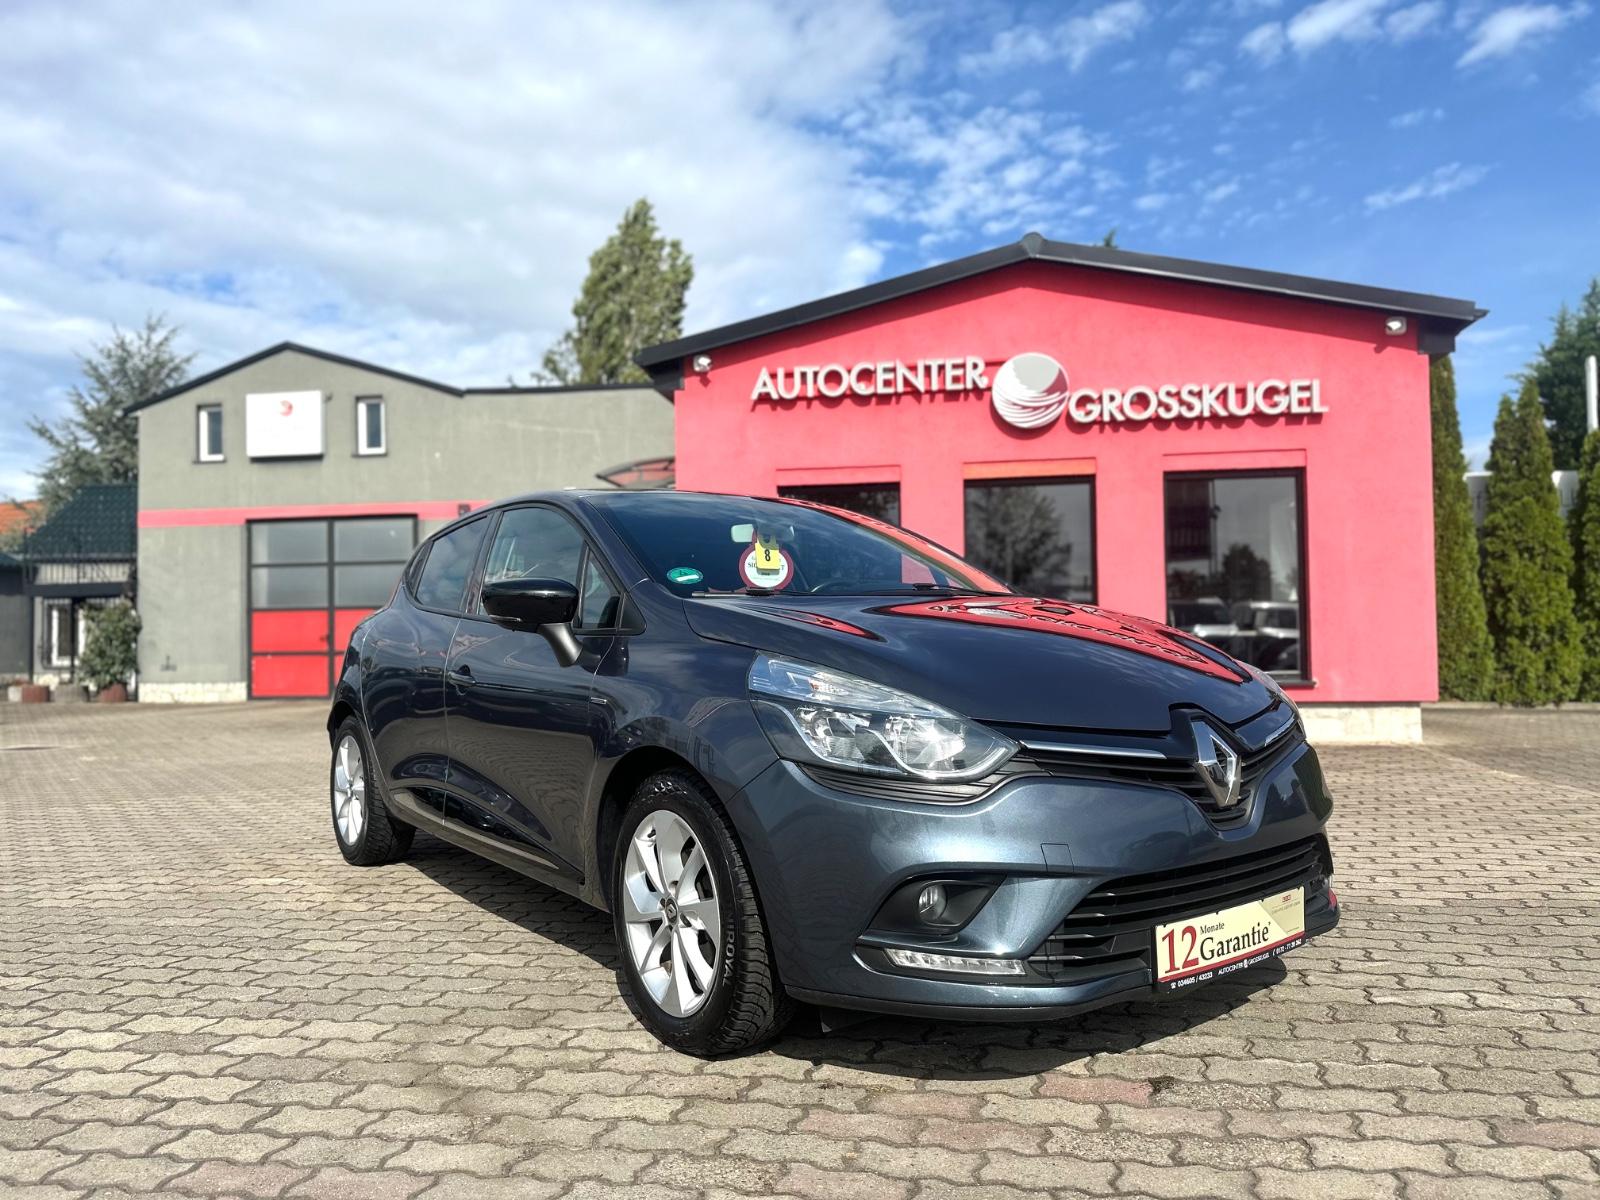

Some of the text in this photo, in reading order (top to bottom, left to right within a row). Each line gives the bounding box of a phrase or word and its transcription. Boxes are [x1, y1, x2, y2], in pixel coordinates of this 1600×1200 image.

[750, 356, 1329, 424] AUTOCENTER GROSSKUGEL
[764, 549, 771, 561] 8
[1200, 921, 1225, 936] Monate
[1162, 925, 1199, 974] 12
